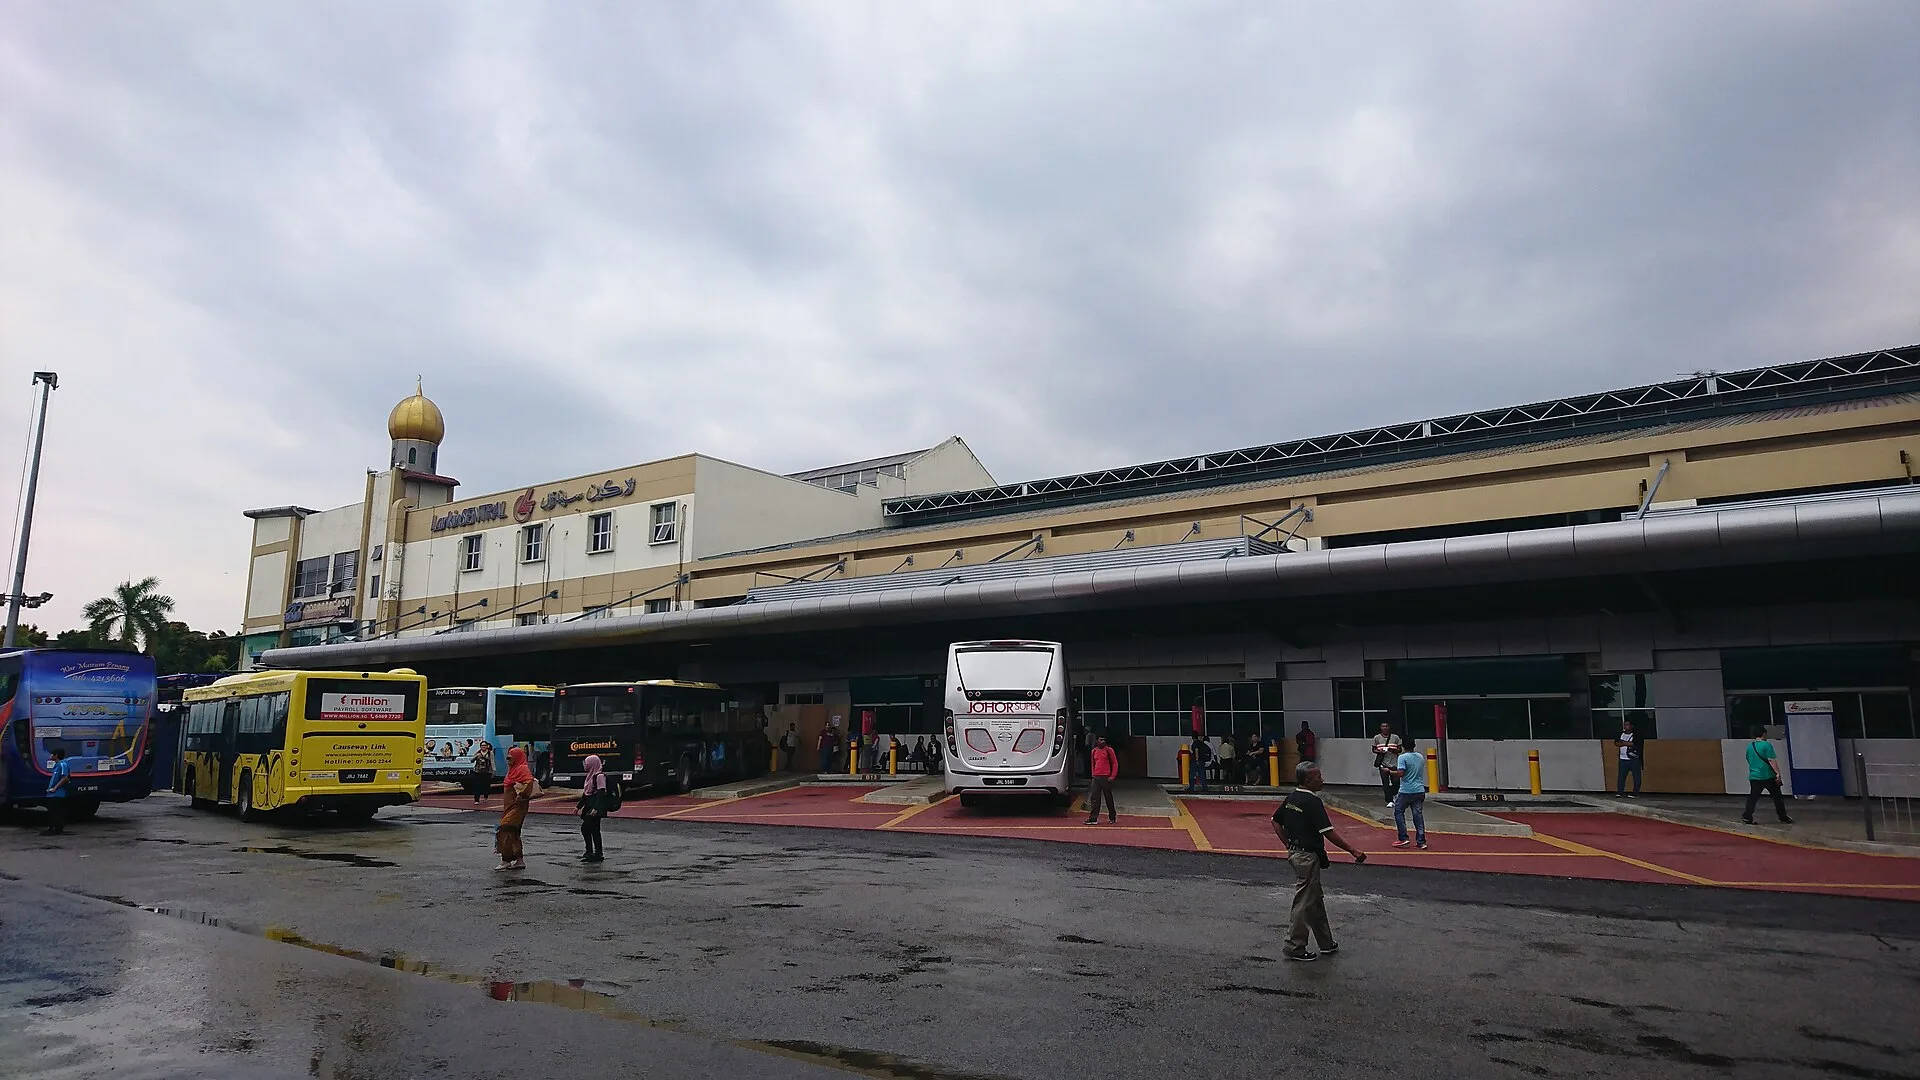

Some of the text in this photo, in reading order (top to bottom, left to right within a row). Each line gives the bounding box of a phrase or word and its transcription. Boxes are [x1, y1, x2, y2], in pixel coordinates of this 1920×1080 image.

[60, 661, 130, 673] War Museum Penang
[351, 697, 388, 705] million
[967, 702, 1041, 713] JOHOR SUPER
[570, 741, 611, 752] Continental
